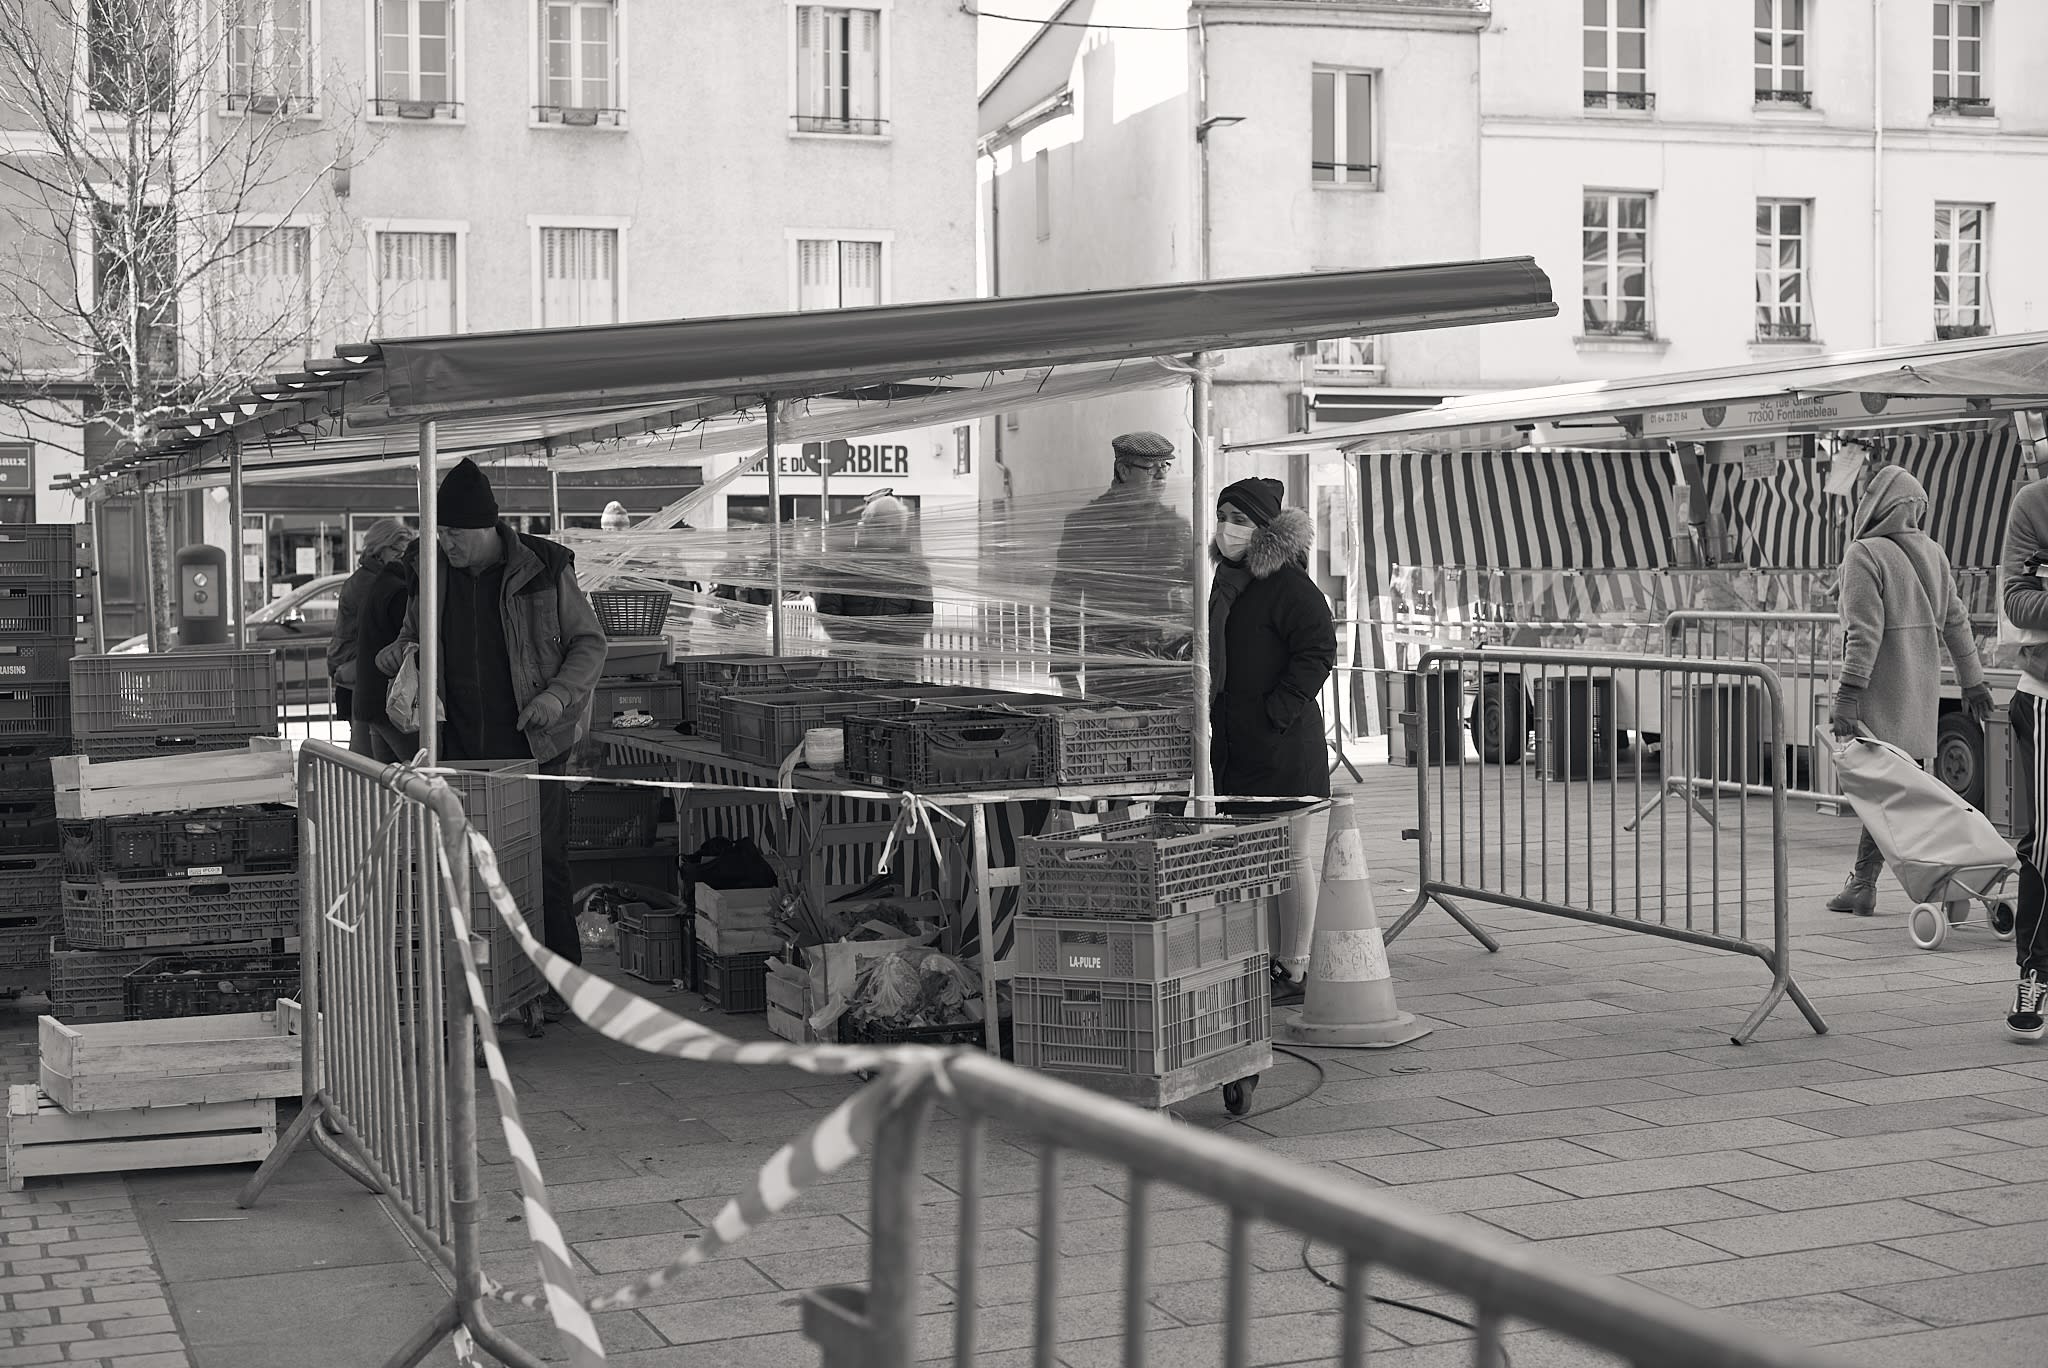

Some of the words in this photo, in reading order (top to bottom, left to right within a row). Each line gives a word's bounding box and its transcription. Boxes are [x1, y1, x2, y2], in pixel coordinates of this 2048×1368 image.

[1748, 409, 1775, 423] 77300
[1777, 406, 1838, 421] Fontainebleau
[0, 457, 27, 466] aux
[791, 456, 807, 473] DU
[835, 444, 909, 473] RBIER
[1069, 956, 1101, 969] LA-PULPE
